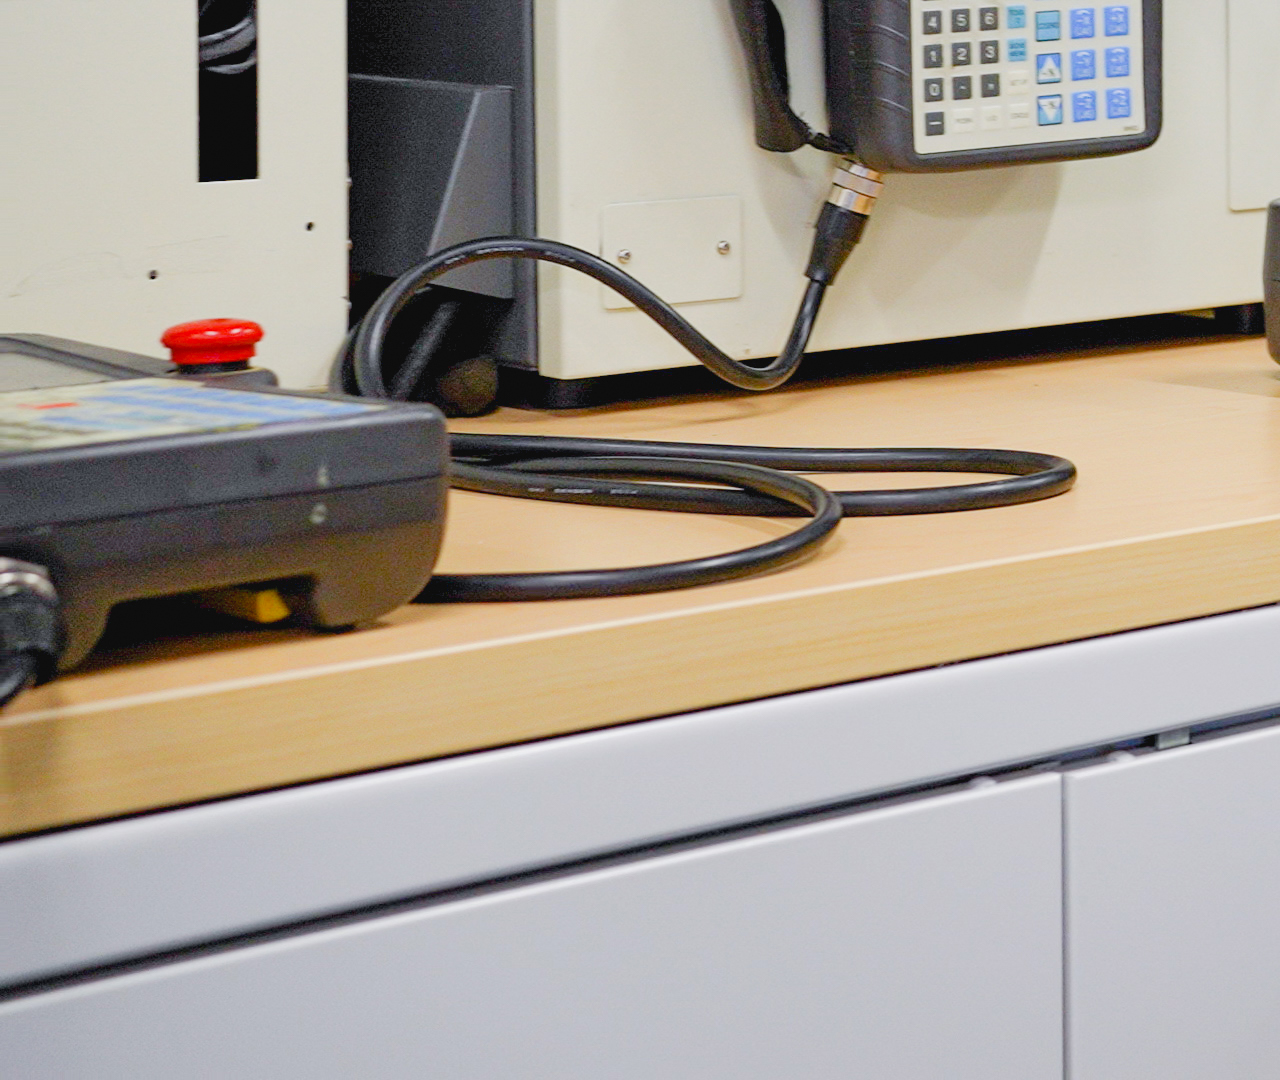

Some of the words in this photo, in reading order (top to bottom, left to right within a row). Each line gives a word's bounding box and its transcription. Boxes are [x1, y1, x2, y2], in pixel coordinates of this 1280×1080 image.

[956, 14, 967, 27] 5
[984, 12, 995, 25] 6
[956, 47, 967, 60] 2
[985, 45, 995, 59] 3
[929, 83, 940, 96] 0
